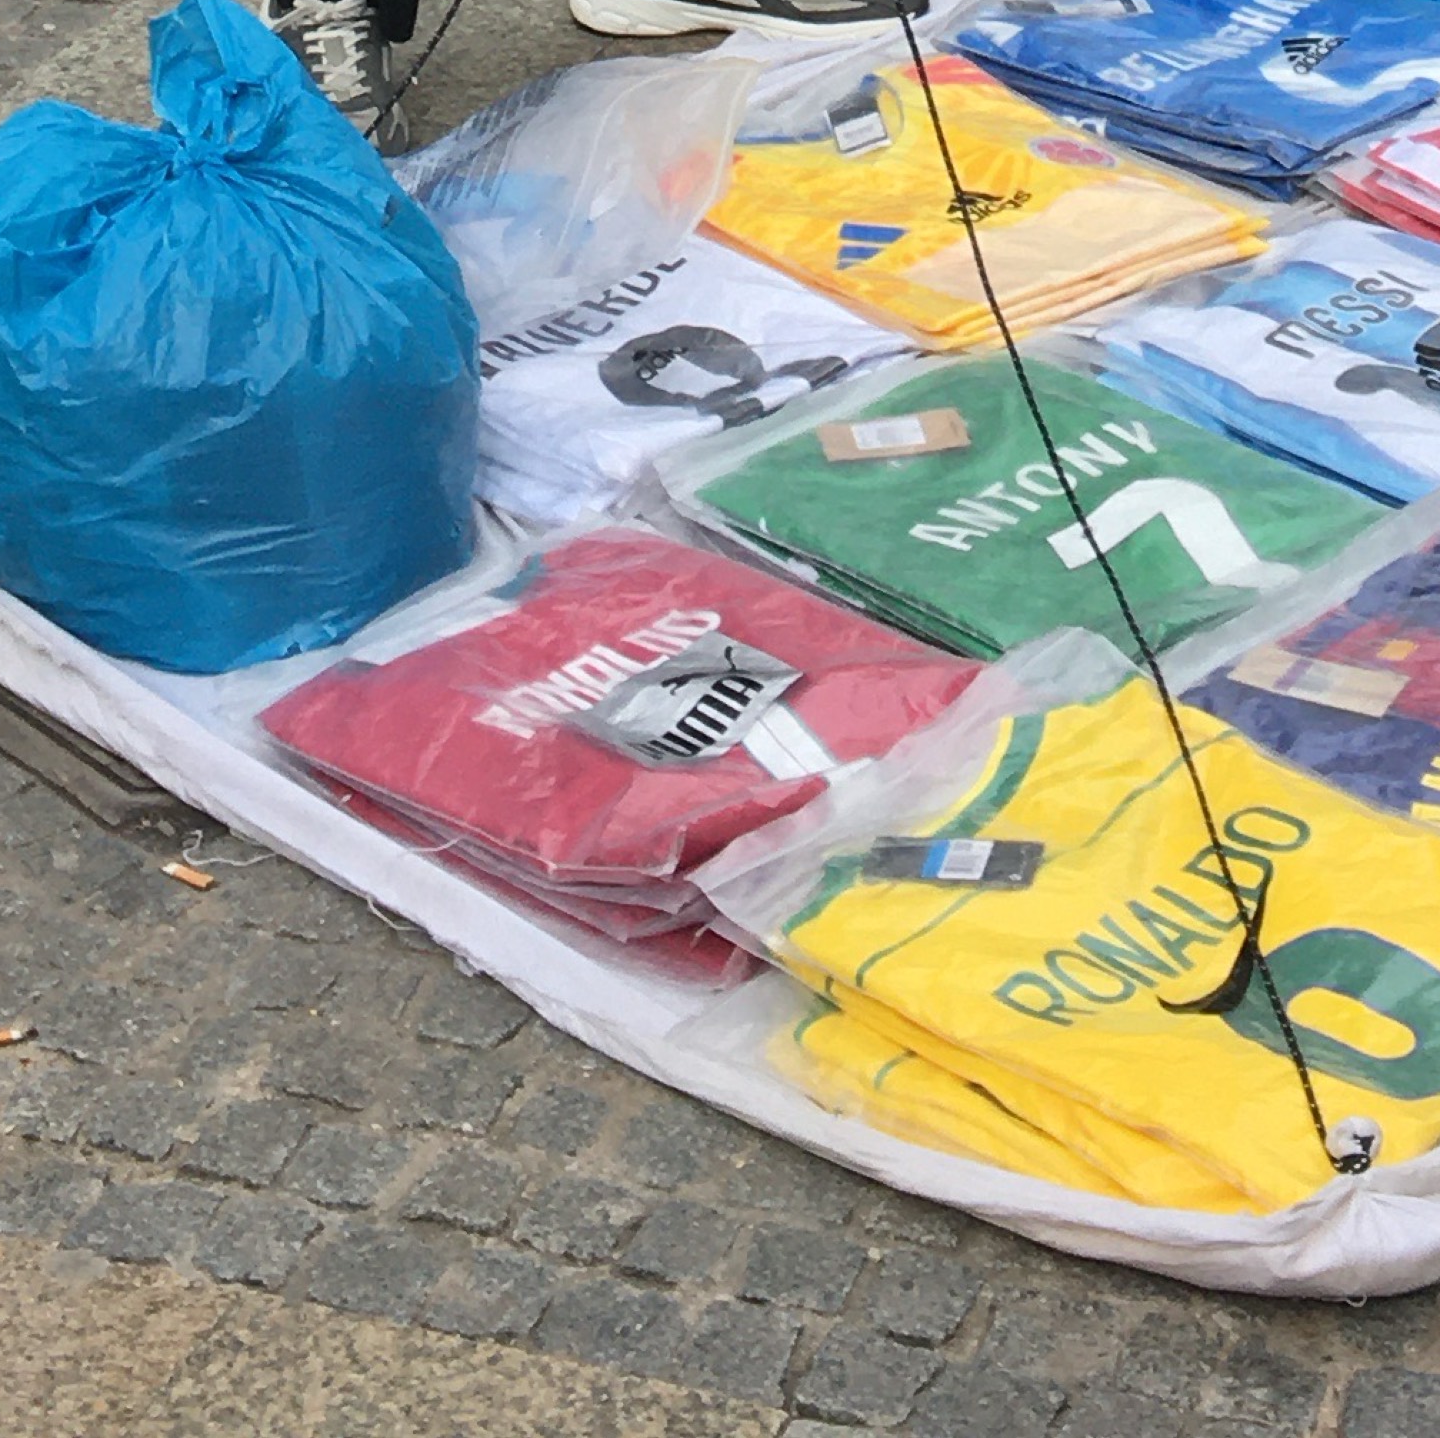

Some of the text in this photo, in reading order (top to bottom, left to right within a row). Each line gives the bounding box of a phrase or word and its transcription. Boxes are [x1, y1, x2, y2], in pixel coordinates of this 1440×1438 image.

[1265, 270, 1430, 359] MESSI
[911, 418, 1158, 555] ANTONY
[472, 610, 722, 740] RONALDO
[995, 805, 1309, 1027] RONALDO
